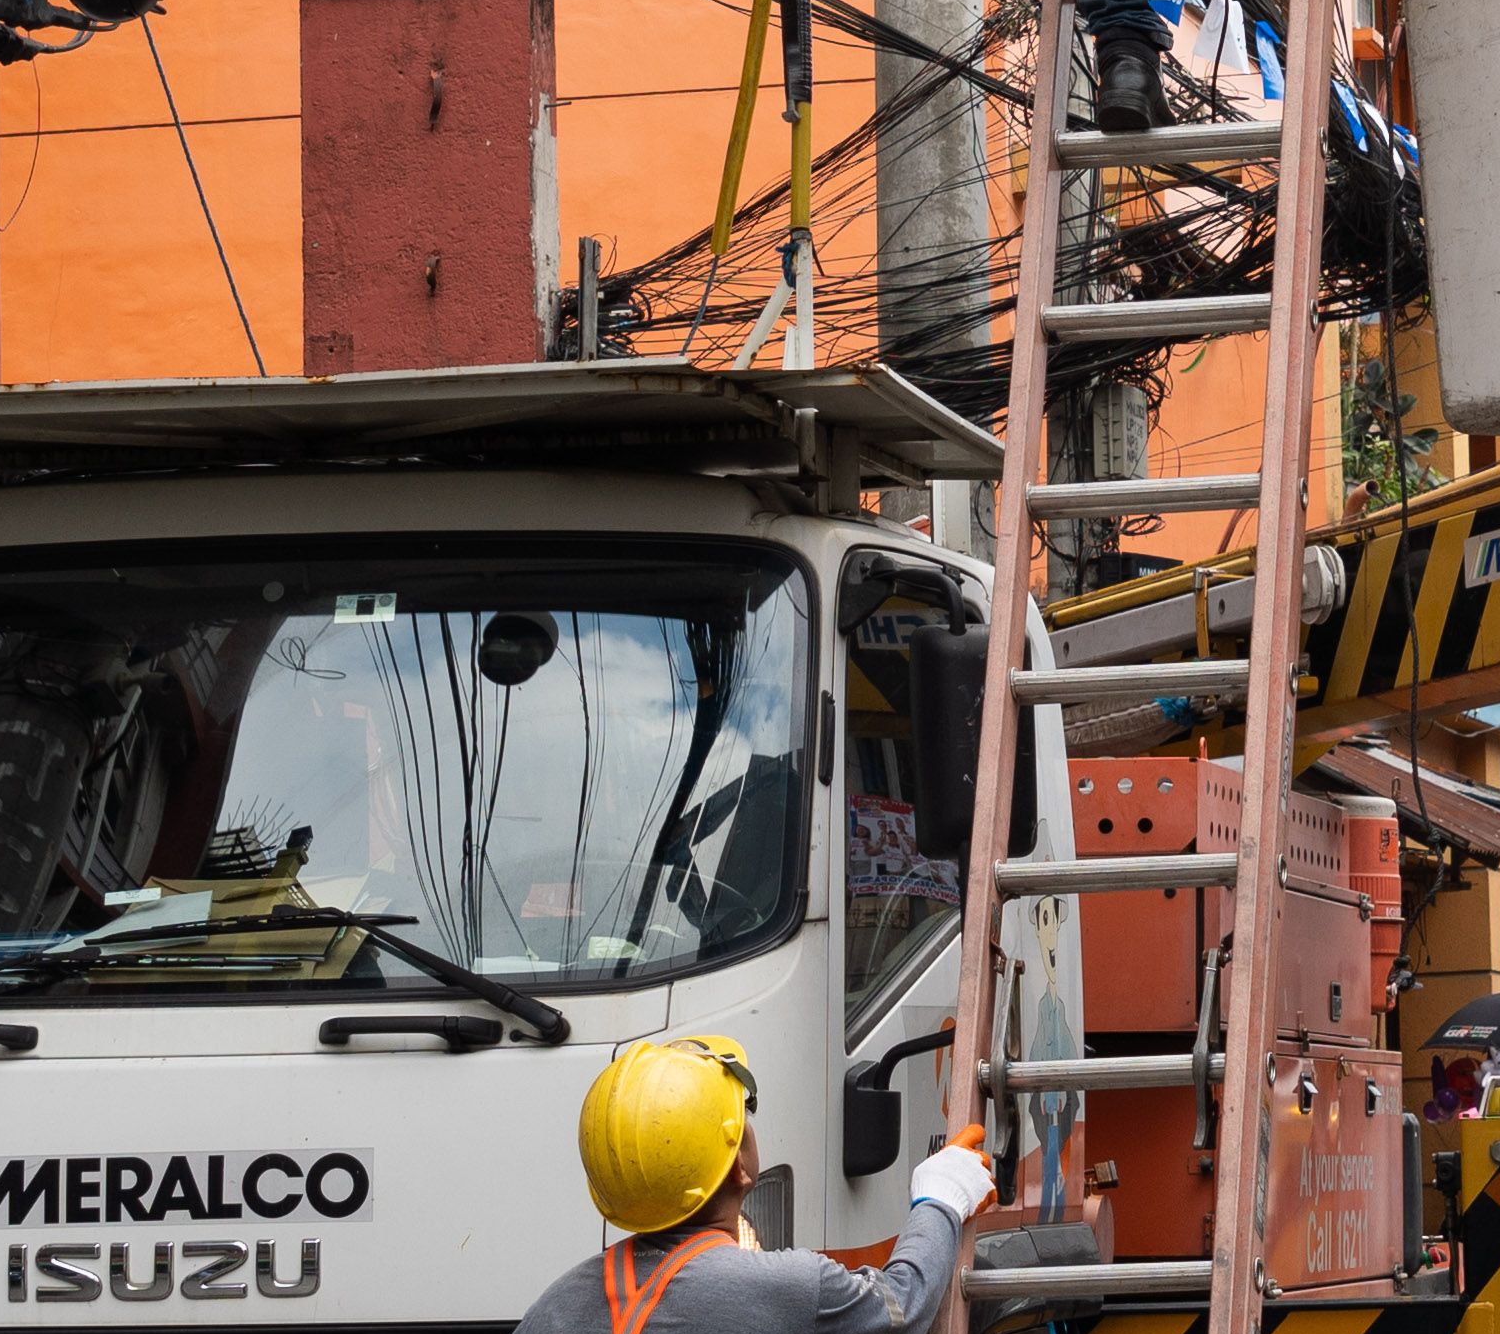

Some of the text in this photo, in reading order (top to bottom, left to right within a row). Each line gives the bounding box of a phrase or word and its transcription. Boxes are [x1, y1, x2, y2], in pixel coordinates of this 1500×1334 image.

[1299, 1147, 1374, 1206] At your service
[7, 1238, 322, 1303] ISUZU
[1306, 1210, 1369, 1273] Call 16211
